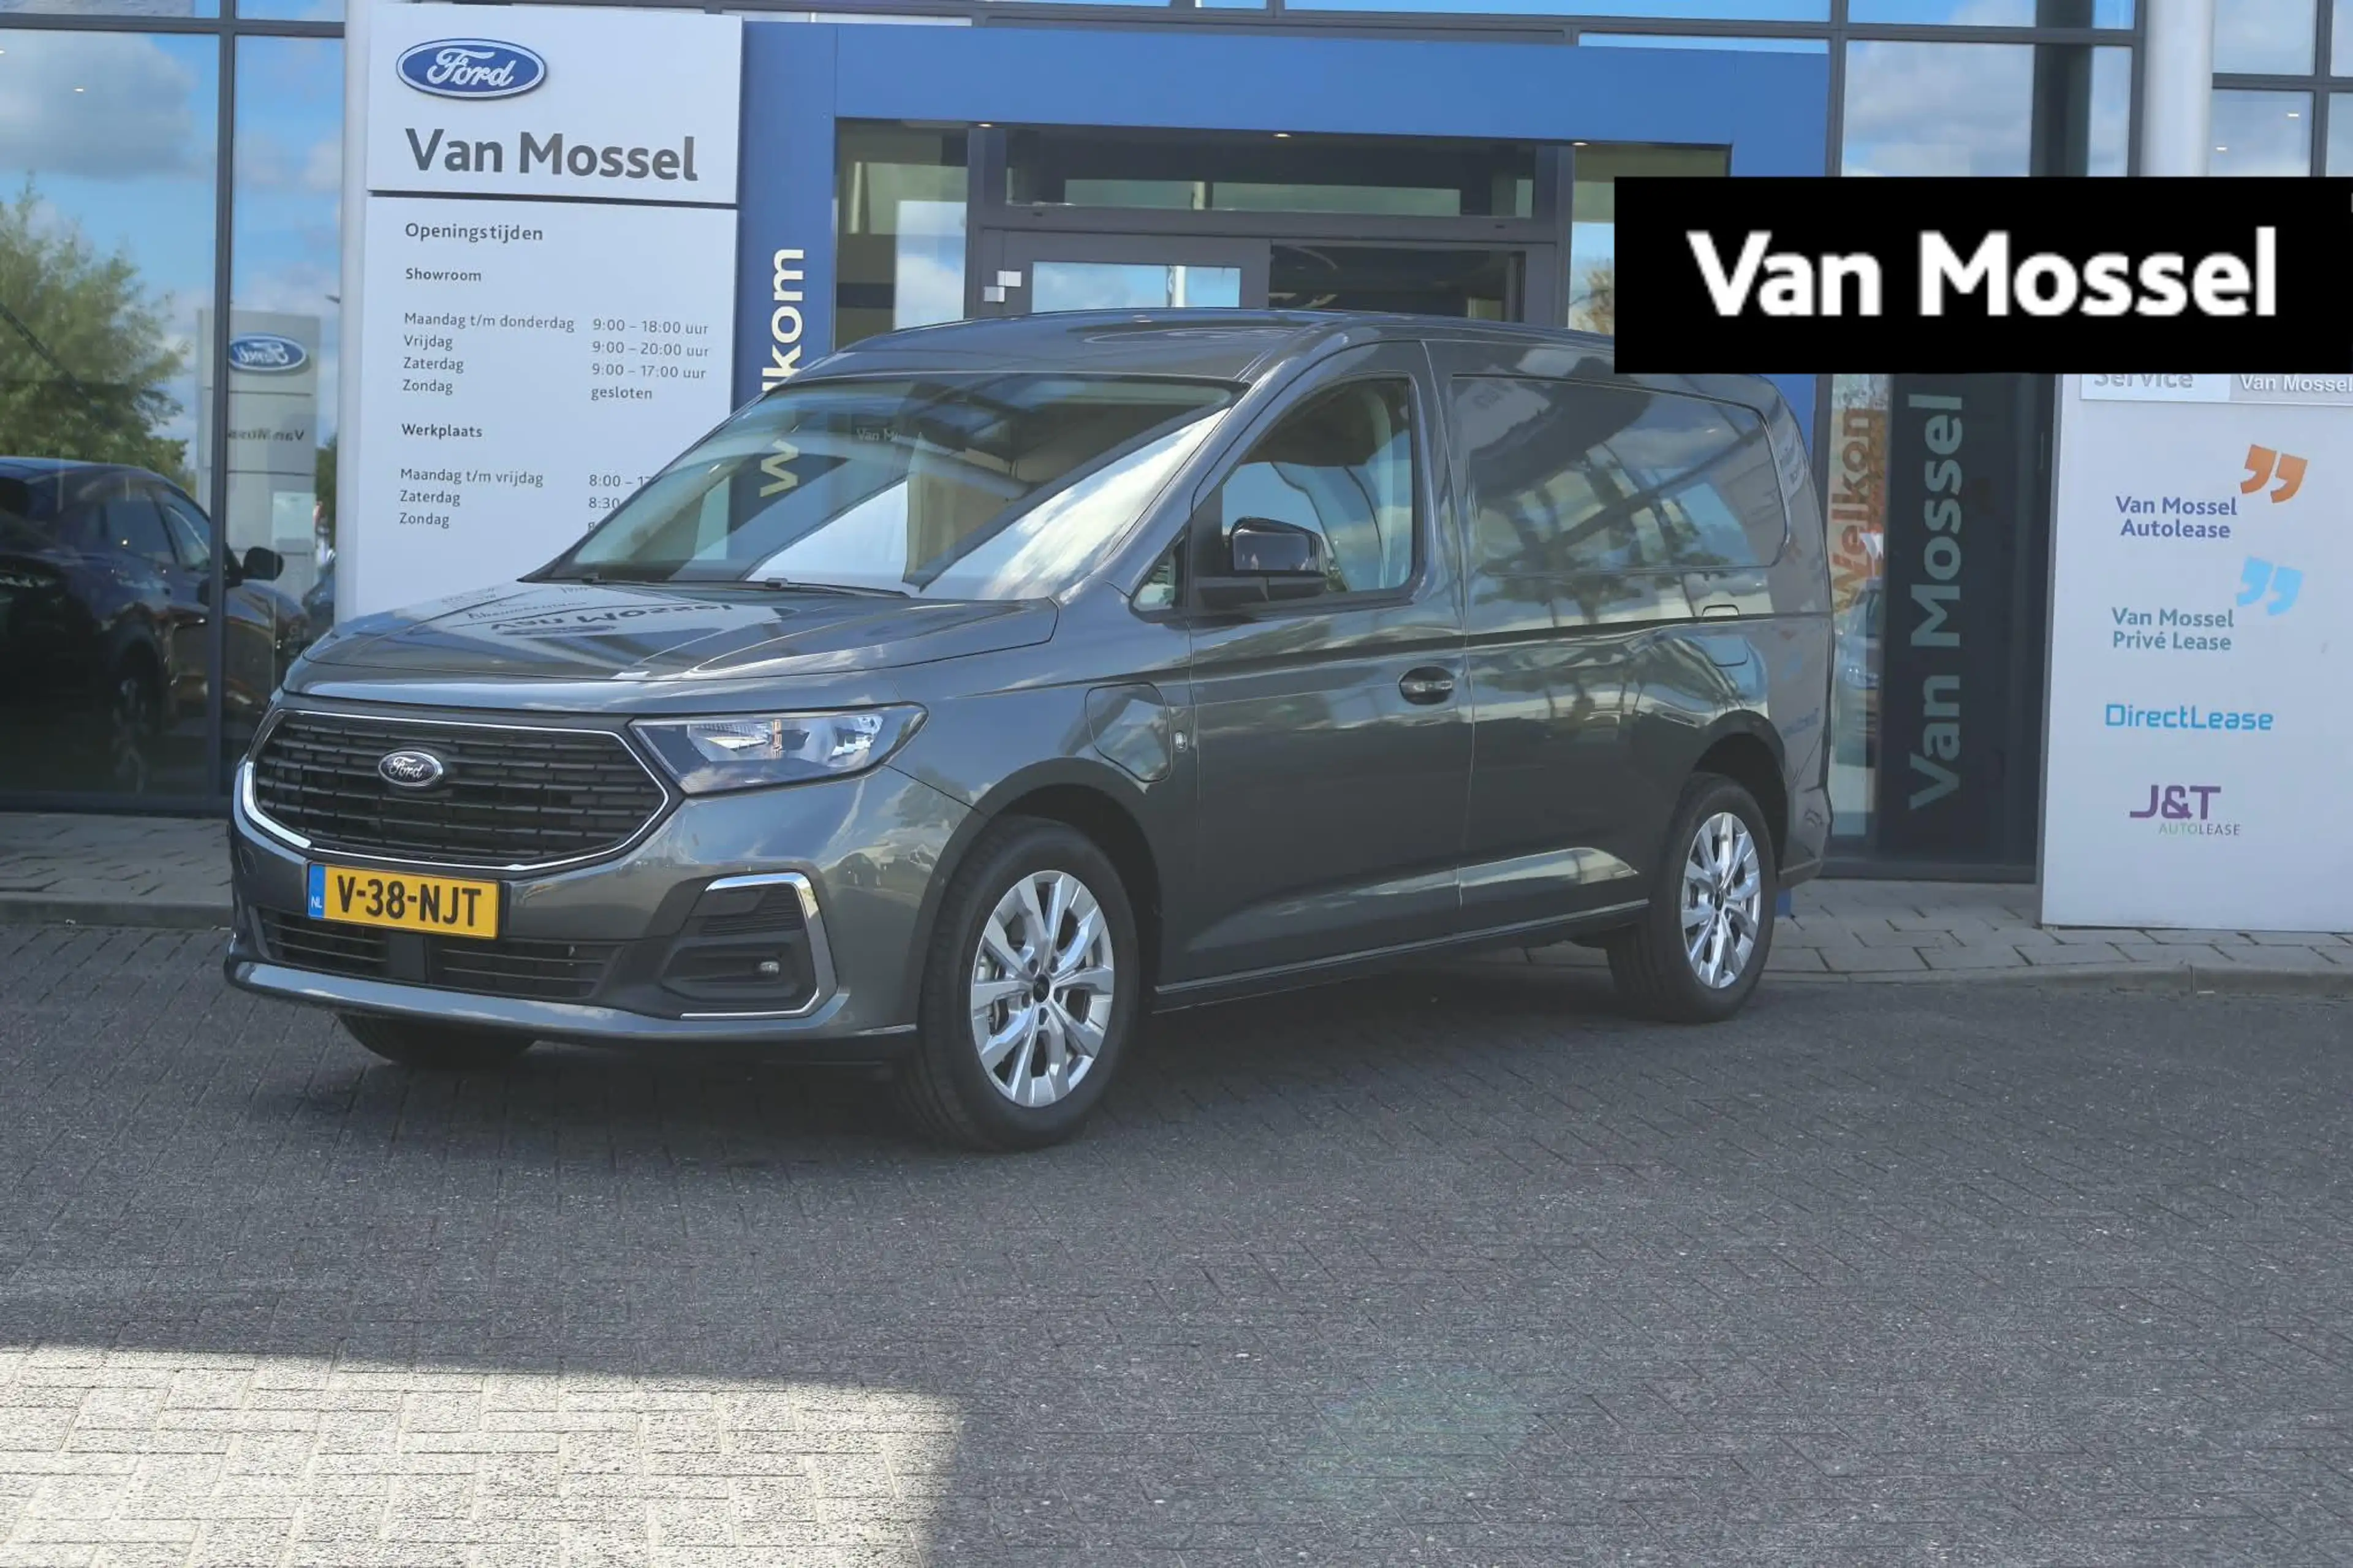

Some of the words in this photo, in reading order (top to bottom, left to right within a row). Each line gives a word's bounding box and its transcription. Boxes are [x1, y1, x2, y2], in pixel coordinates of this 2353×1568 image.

[426, 47, 517, 88] Ford
[406, 128, 502, 172] Van
[520, 132, 698, 181] Mossel
[406, 223, 542, 244] Openingstijden
[406, 268, 481, 281] Showroom
[405, 312, 465, 329] Maandag
[471, 314, 494, 326] t/m
[500, 315, 574, 333] donderdag
[594, 319, 624, 331] 9:00
[642, 320, 681, 333] 18:00
[686, 325, 708, 334] uur
[404, 335, 452, 351] Vrijdag
[593, 341, 624, 354] 9:00
[641, 343, 681, 355] 20:00
[687, 347, 708, 357] uur
[404, 357, 463, 374] Zaterdag
[592, 363, 623, 376] 9:00
[641, 365, 678, 377] 17:00
[403, 379, 452, 395] Zondag
[591, 386, 652, 401] gesloten
[2240, 374, 2276, 390] Van
[2283, 374, 2353, 392] Mossel
[402, 424, 482, 439] Werkplaats
[401, 469, 461, 484] Maandag
[466, 471, 491, 482] t/m
[496, 471, 543, 488] vrijdag
[589, 475, 621, 487] 8:00
[401, 490, 460, 507] Zaterdag
[2116, 496, 2154, 513] Van
[2162, 497, 2237, 516] Mossel
[400, 512, 449, 529] Zondag
[1909, 395, 1962, 646] Mossel
[2121, 519, 2230, 538] Autolease
[2112, 607, 2151, 625] Van
[2159, 608, 2234, 627] Mossel
[2113, 630, 2165, 649] Privé
[2173, 632, 2231, 650] Lease
[2105, 704, 2273, 730] DirectLease
[1910, 675, 1960, 809] Van
[2129, 785, 2221, 820] J&T
[2160, 824, 2240, 836] AUTOLEASE
[311, 896, 322, 909] NL
[337, 875, 482, 927] V-38-NJT
